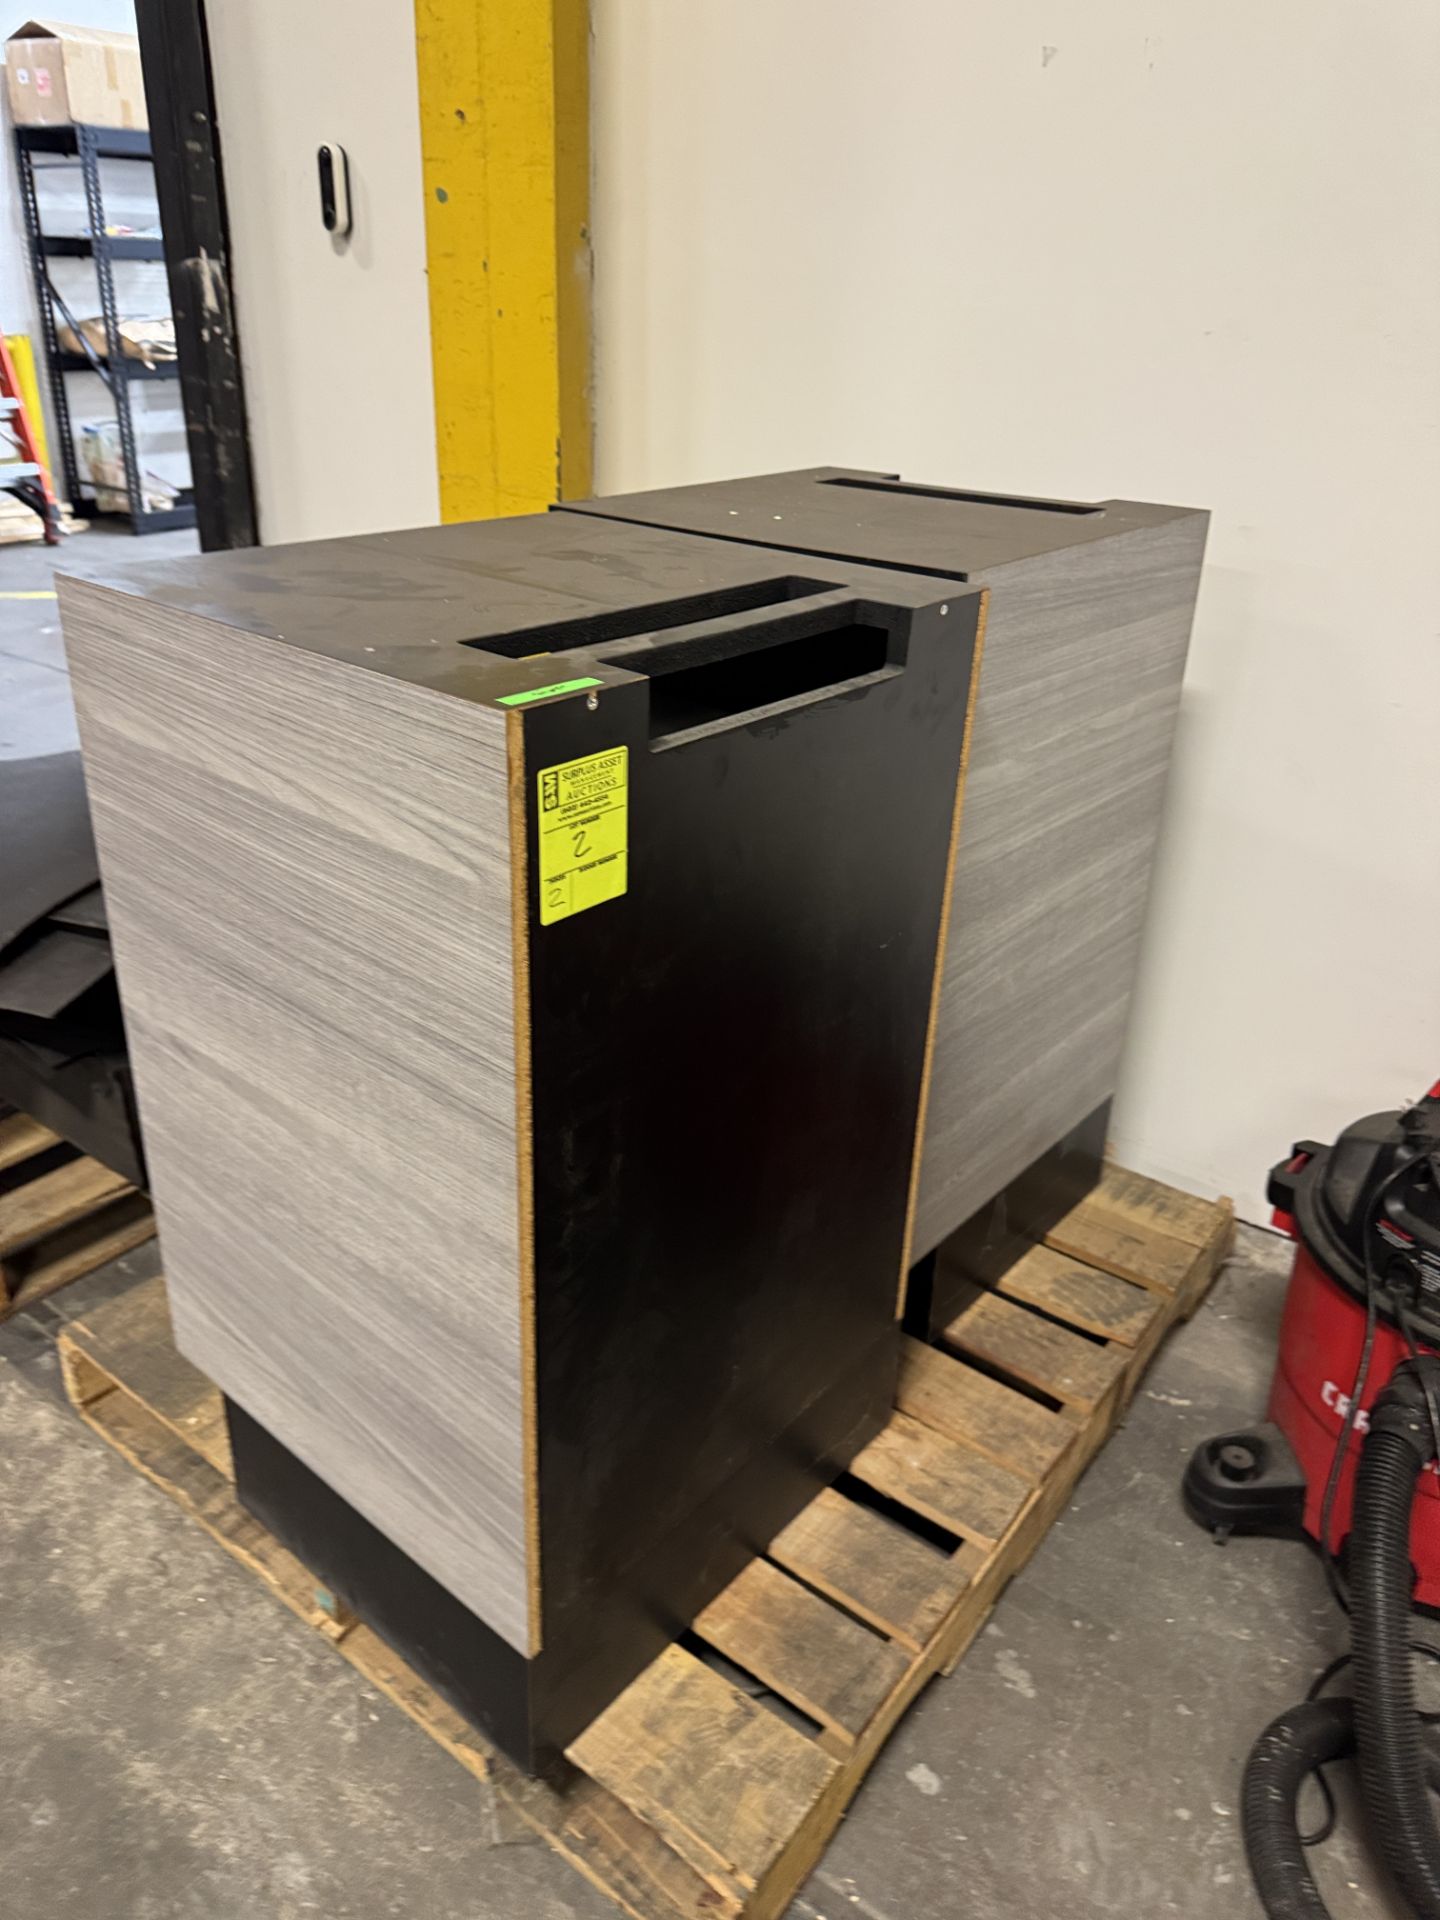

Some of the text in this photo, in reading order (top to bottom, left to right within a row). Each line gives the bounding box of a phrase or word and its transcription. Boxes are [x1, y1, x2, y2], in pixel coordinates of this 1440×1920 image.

[598, 755, 622, 769] ASSET
[567, 776, 617, 801] AUCTIONS
[572, 831, 593, 858] 2
[548, 887, 567, 908] 2
